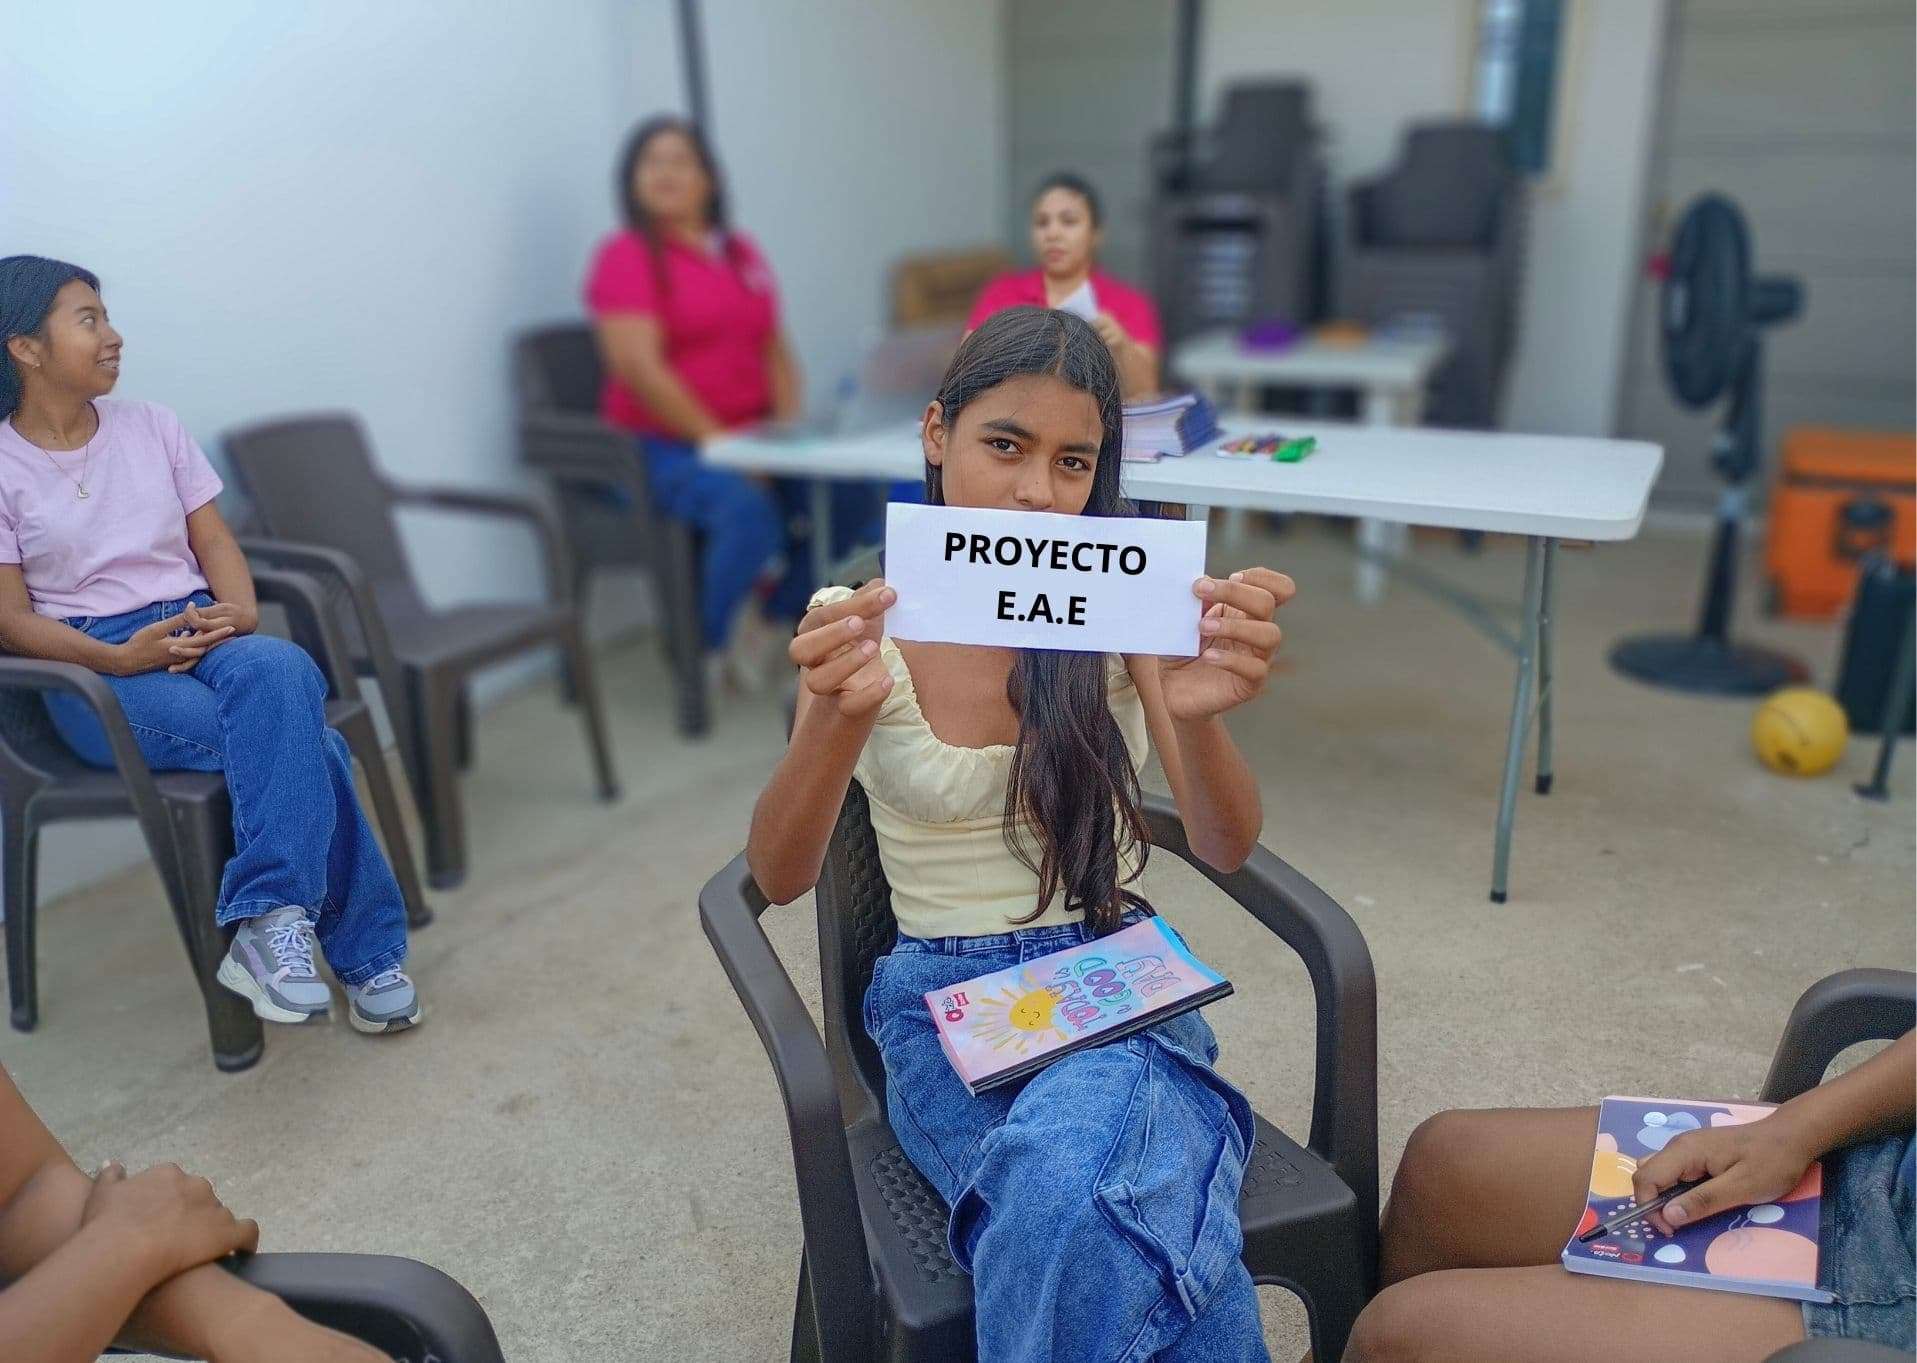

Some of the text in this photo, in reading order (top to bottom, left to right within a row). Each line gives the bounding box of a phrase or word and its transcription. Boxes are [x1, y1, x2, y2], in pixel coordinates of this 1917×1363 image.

[945, 532, 1146, 575] PROYECTO
[997, 591, 1087, 626] E.A.E
[1073, 956, 1131, 1007] GOOD
[1116, 955, 1181, 998] DAY
[1045, 980, 1106, 1032] TODAY
